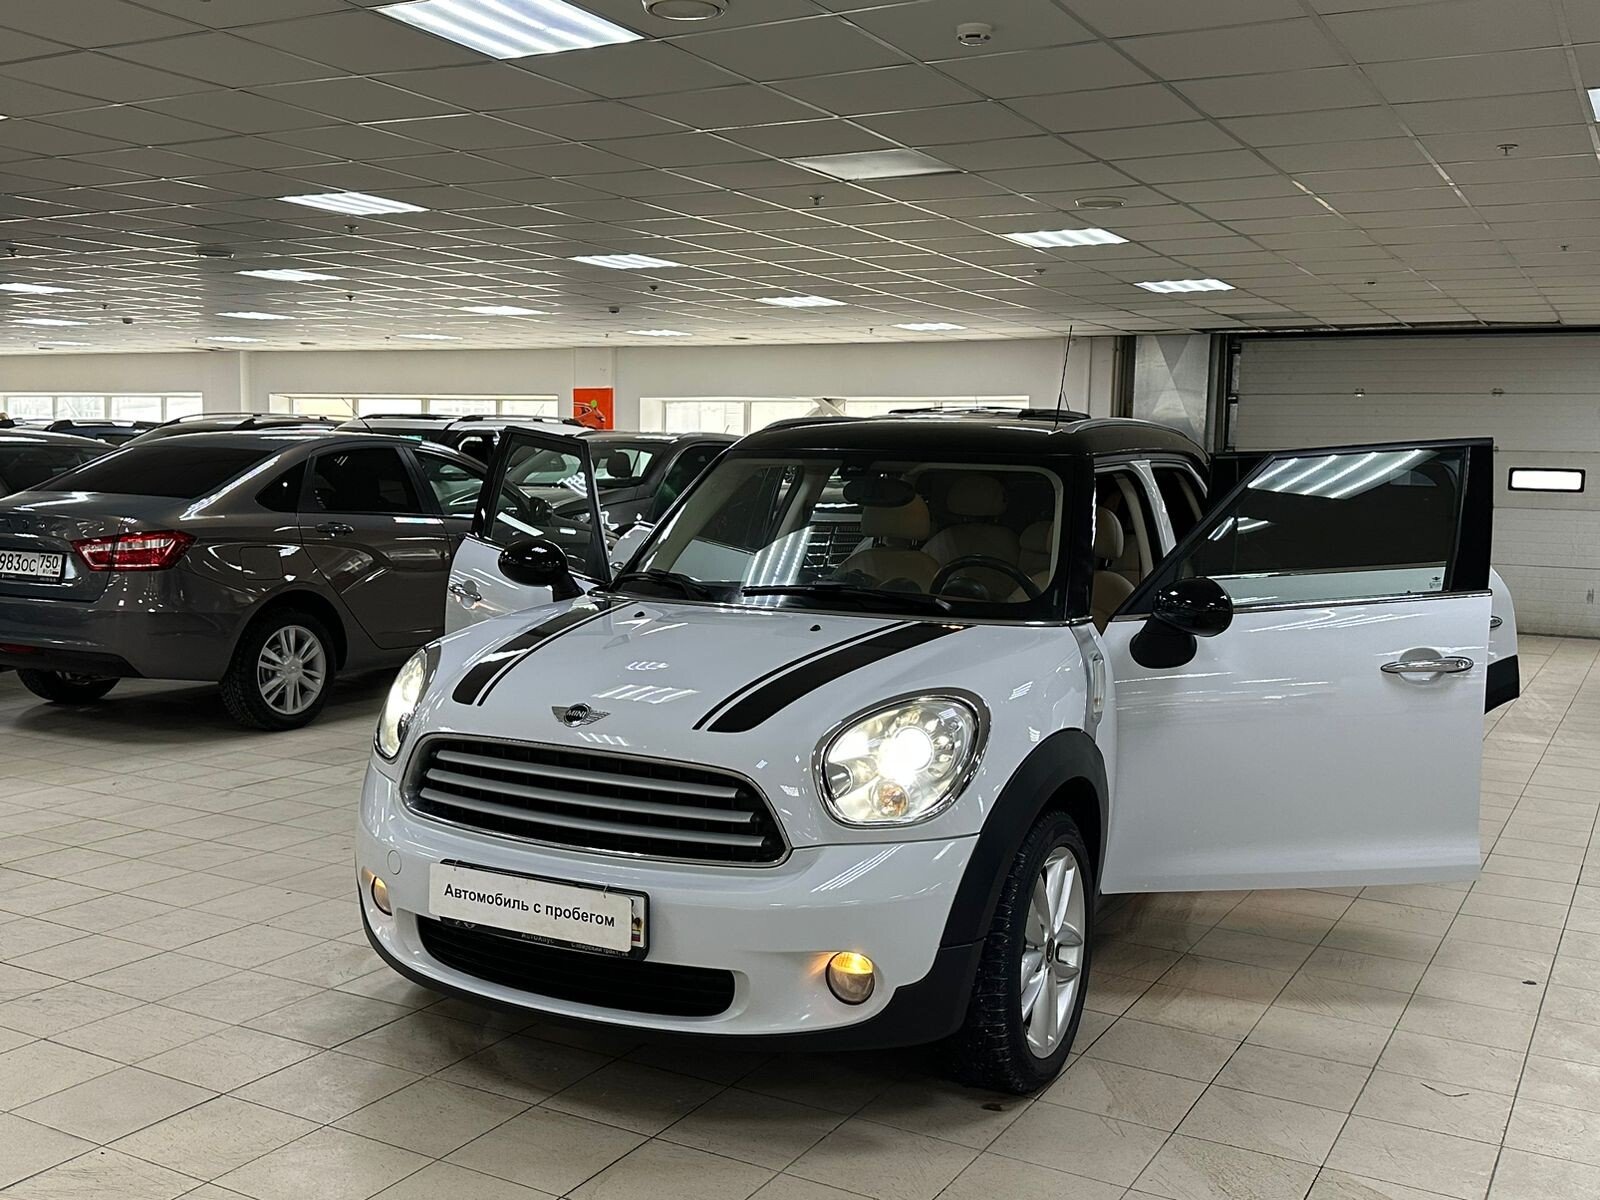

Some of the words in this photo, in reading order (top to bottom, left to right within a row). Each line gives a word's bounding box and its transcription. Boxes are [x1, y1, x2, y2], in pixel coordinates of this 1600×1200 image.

[40, 554, 58, 569] 750
[567, 710, 587, 718] MINI
[444, 883, 529, 912] Автомобиль
[533, 902, 542, 914] с
[545, 903, 616, 927] пробегом
